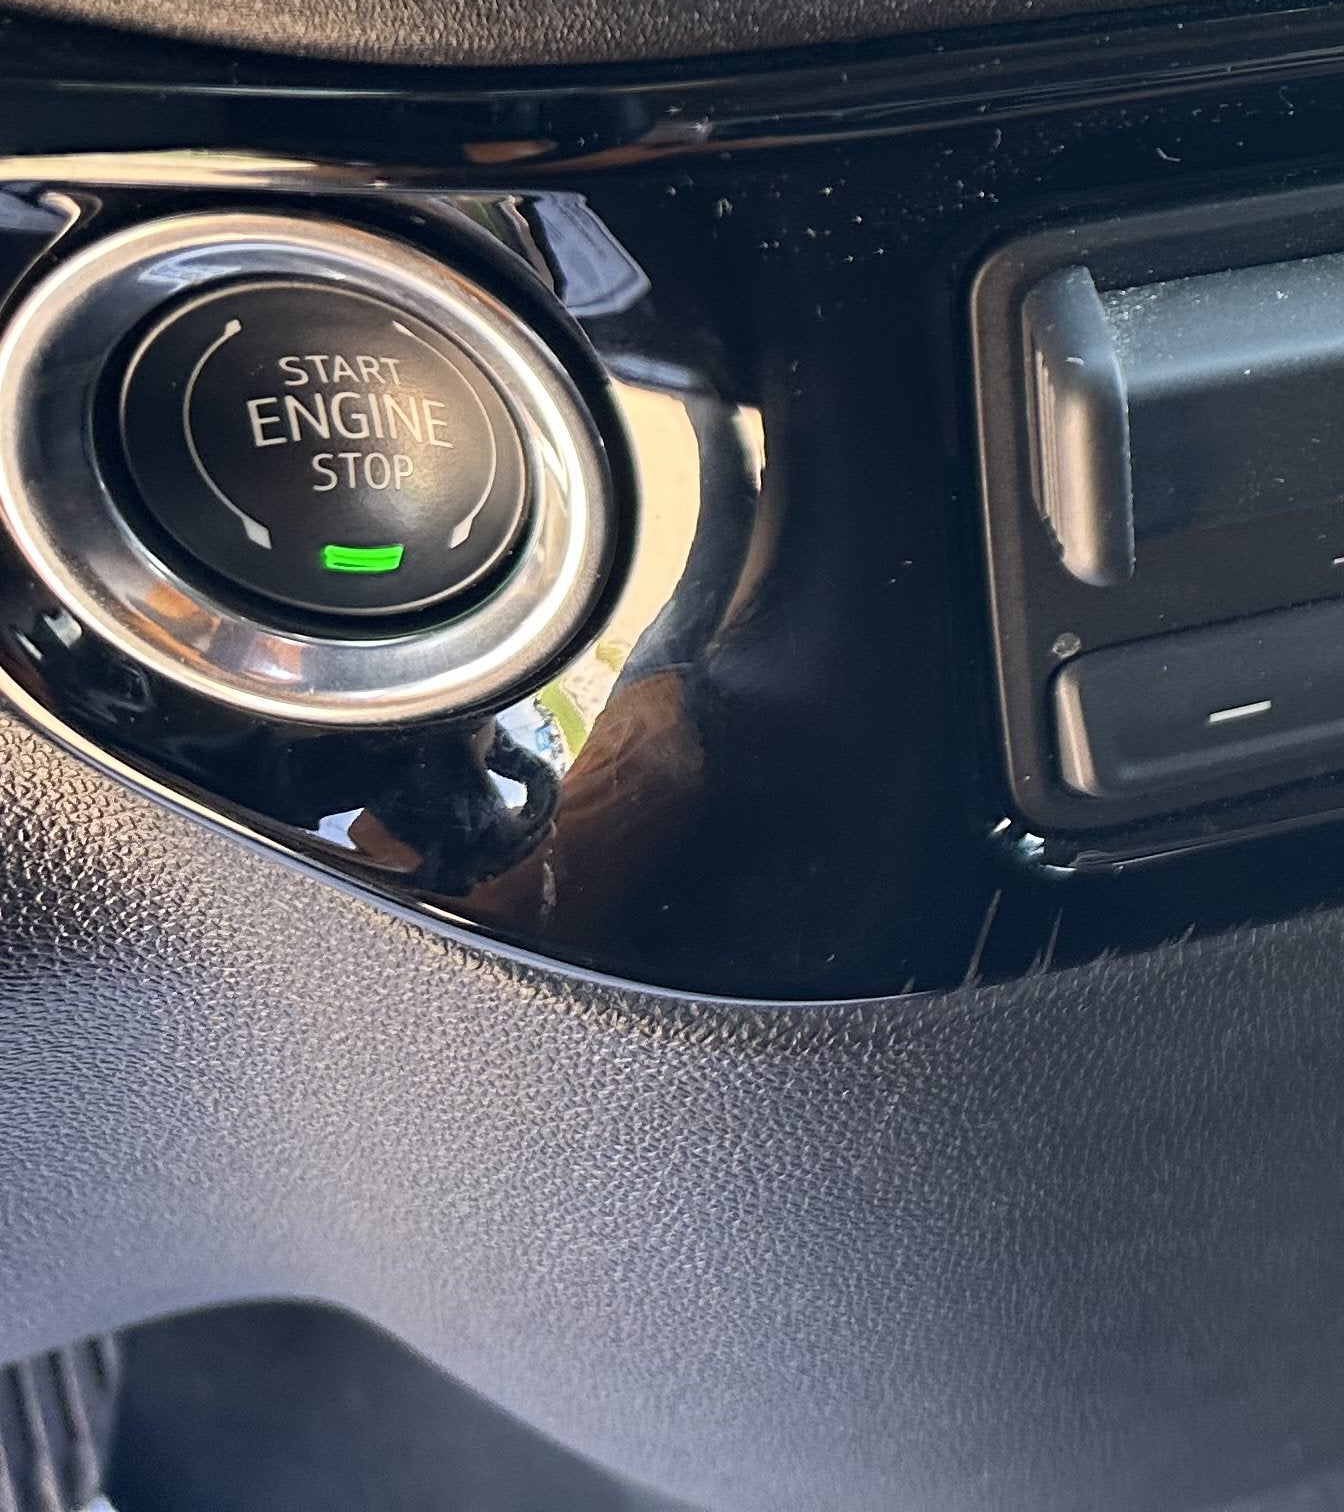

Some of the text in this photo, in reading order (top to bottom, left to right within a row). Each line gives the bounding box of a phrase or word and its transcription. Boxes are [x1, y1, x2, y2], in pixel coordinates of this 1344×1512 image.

[278, 355, 401, 386] START
[247, 391, 454, 449] ENGINE
[312, 452, 414, 491] STOP
